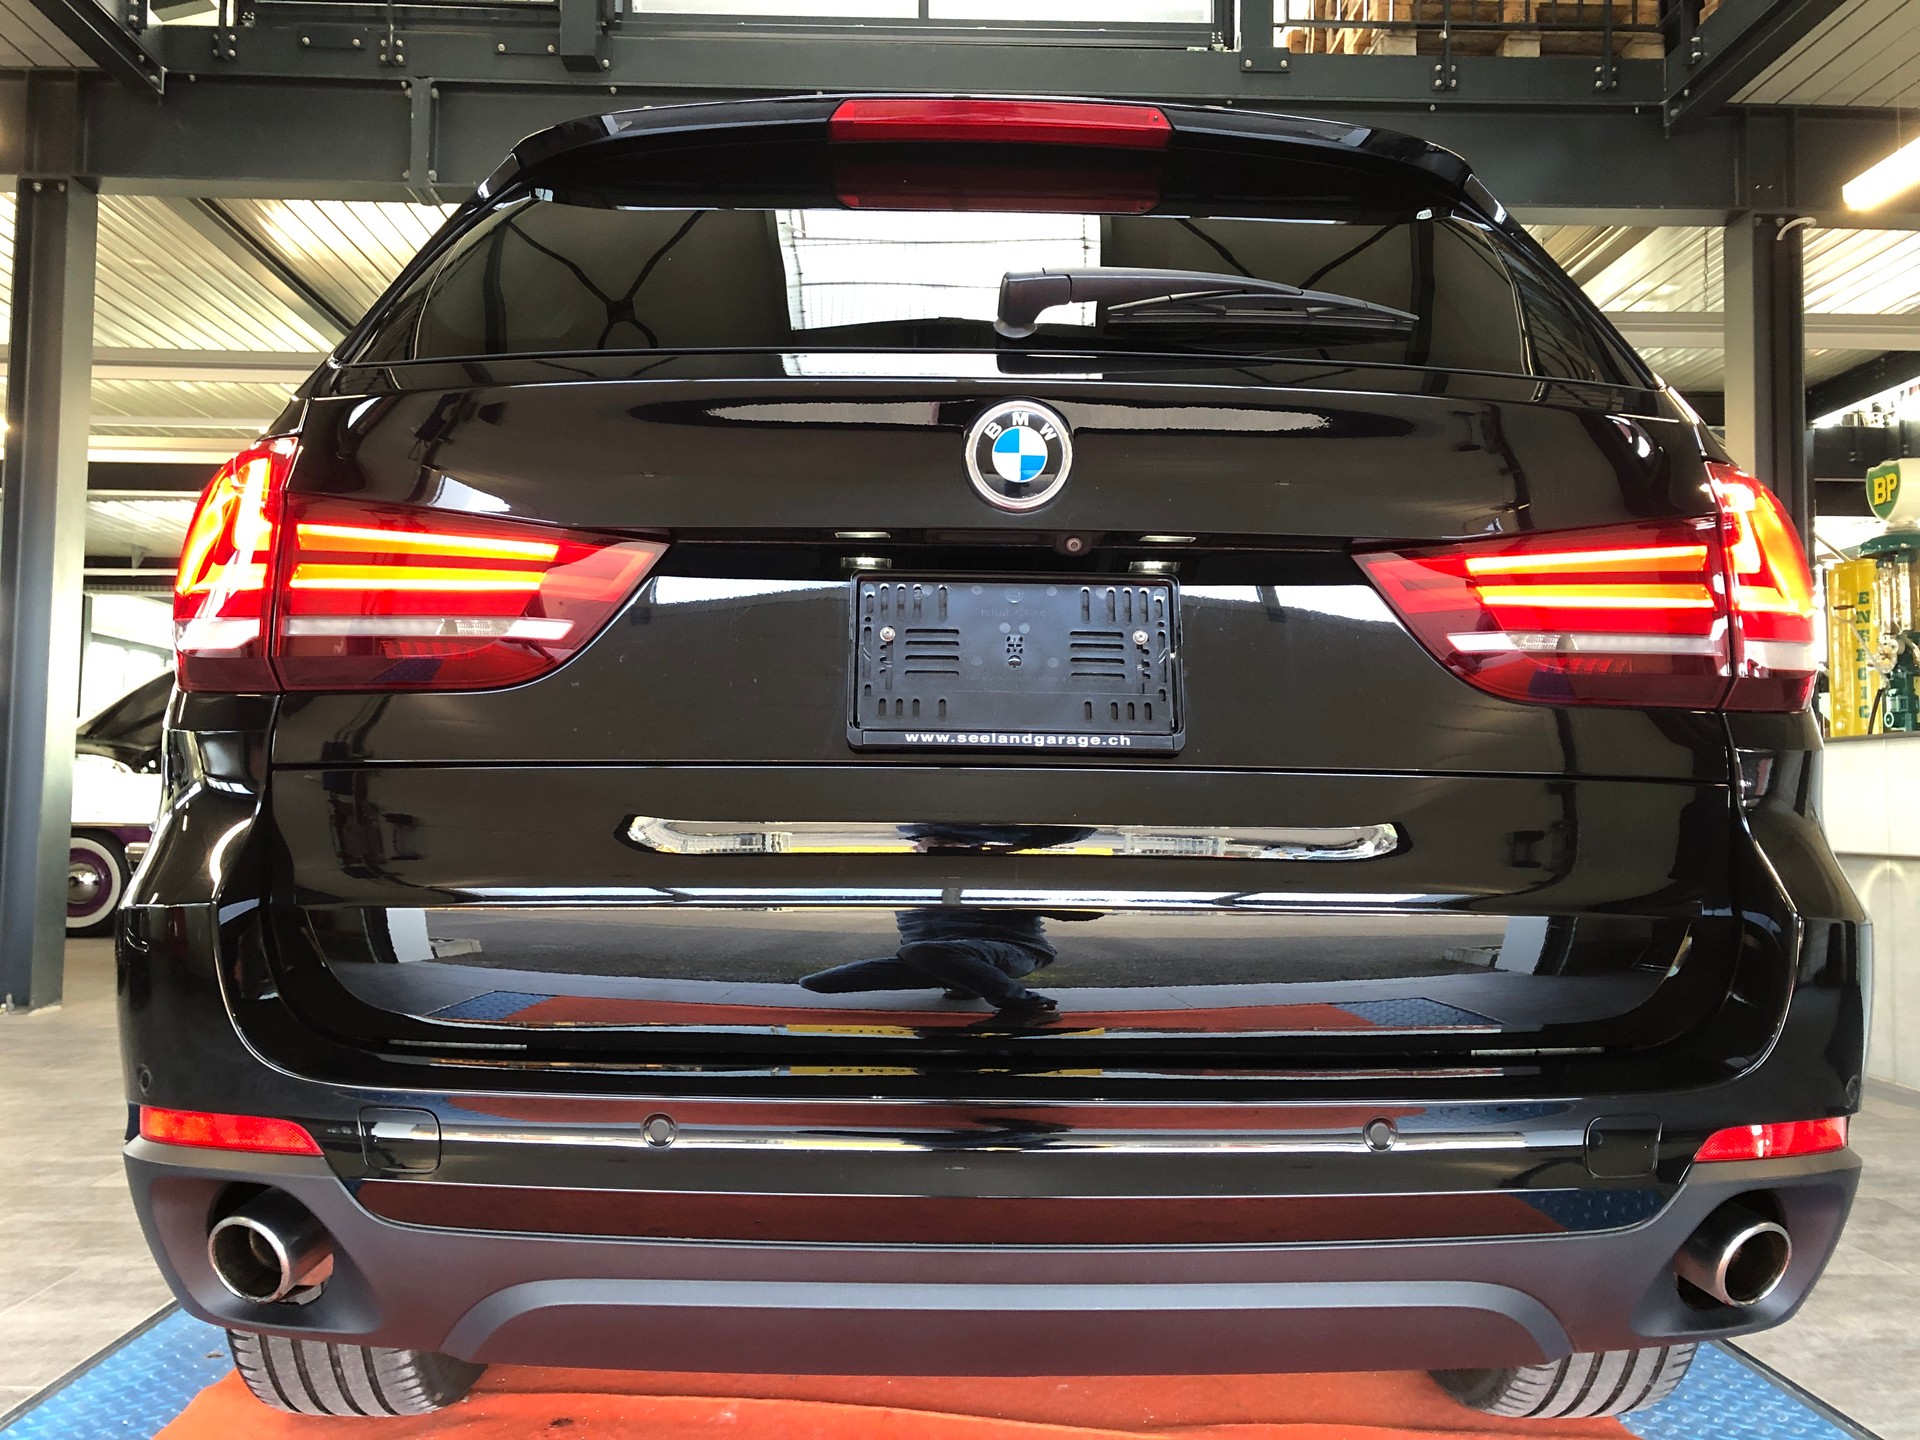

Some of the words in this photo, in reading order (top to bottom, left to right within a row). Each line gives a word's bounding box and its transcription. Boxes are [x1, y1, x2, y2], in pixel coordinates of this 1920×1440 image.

[984, 411, 1057, 441] BMW
[1873, 473, 1897, 505] BP
[905, 732, 1131, 747] www.seelandgarage.ch
